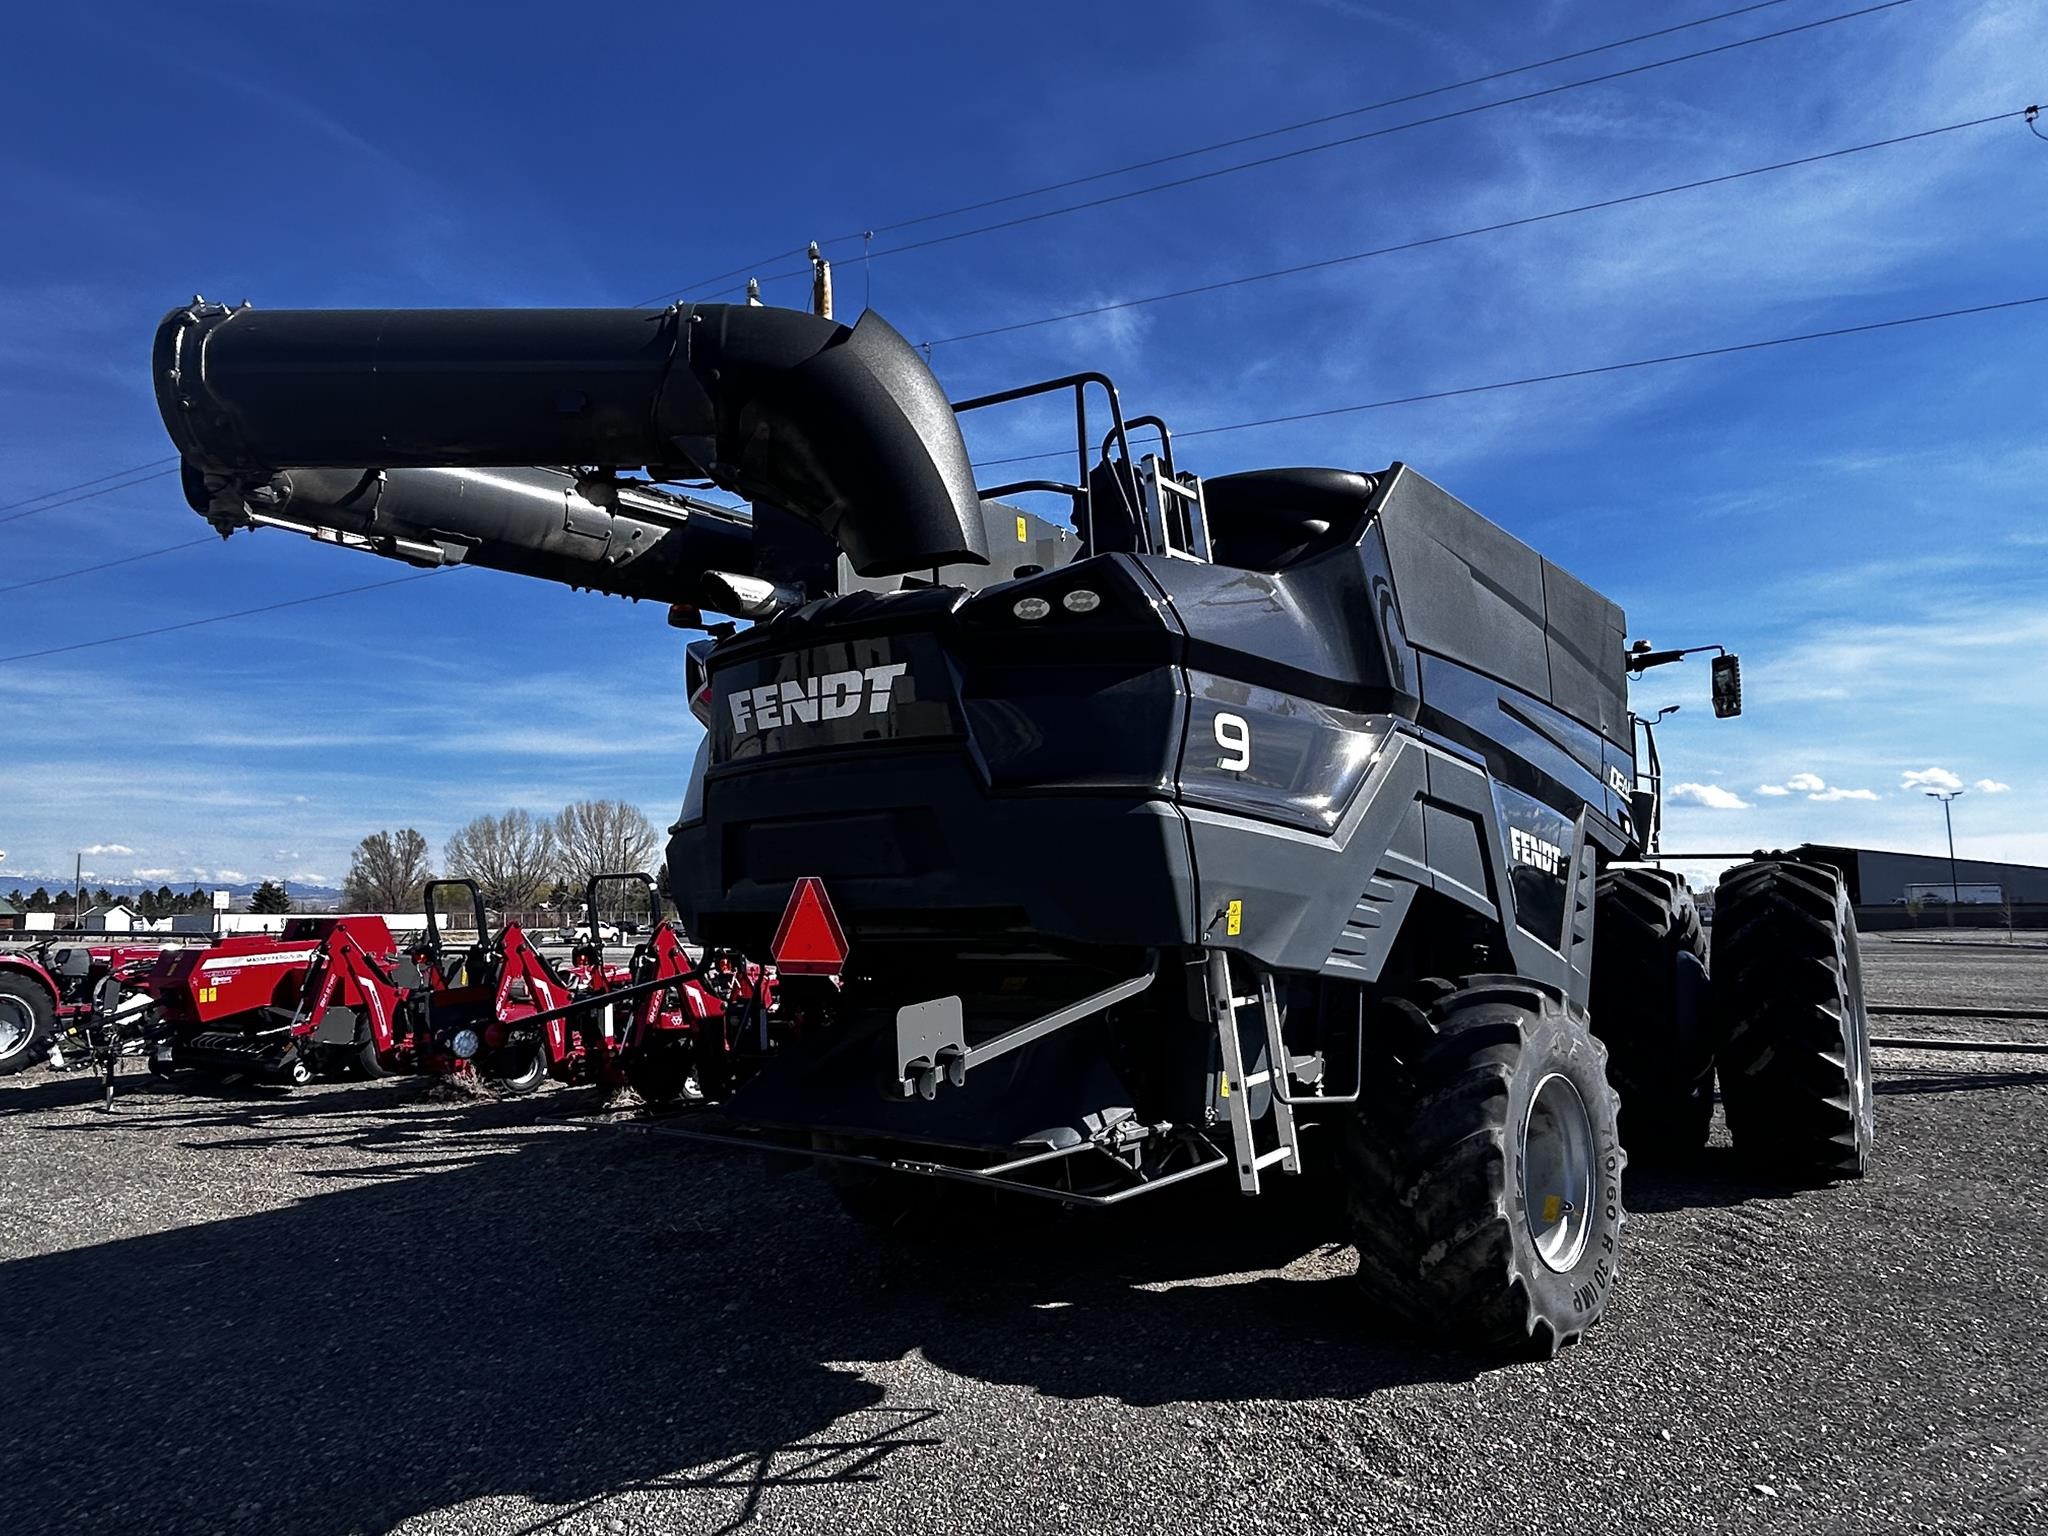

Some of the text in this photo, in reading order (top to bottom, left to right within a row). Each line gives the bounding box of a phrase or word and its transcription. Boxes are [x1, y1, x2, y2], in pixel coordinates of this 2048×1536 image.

[728, 663, 907, 734] FENDT
[1214, 712, 1250, 772] 9
[1510, 827, 1561, 876] FENDT
[1601, 1233, 1614, 1256] R
[1594, 1258, 1610, 1290] 30
[1572, 1281, 1599, 1314] IMP
